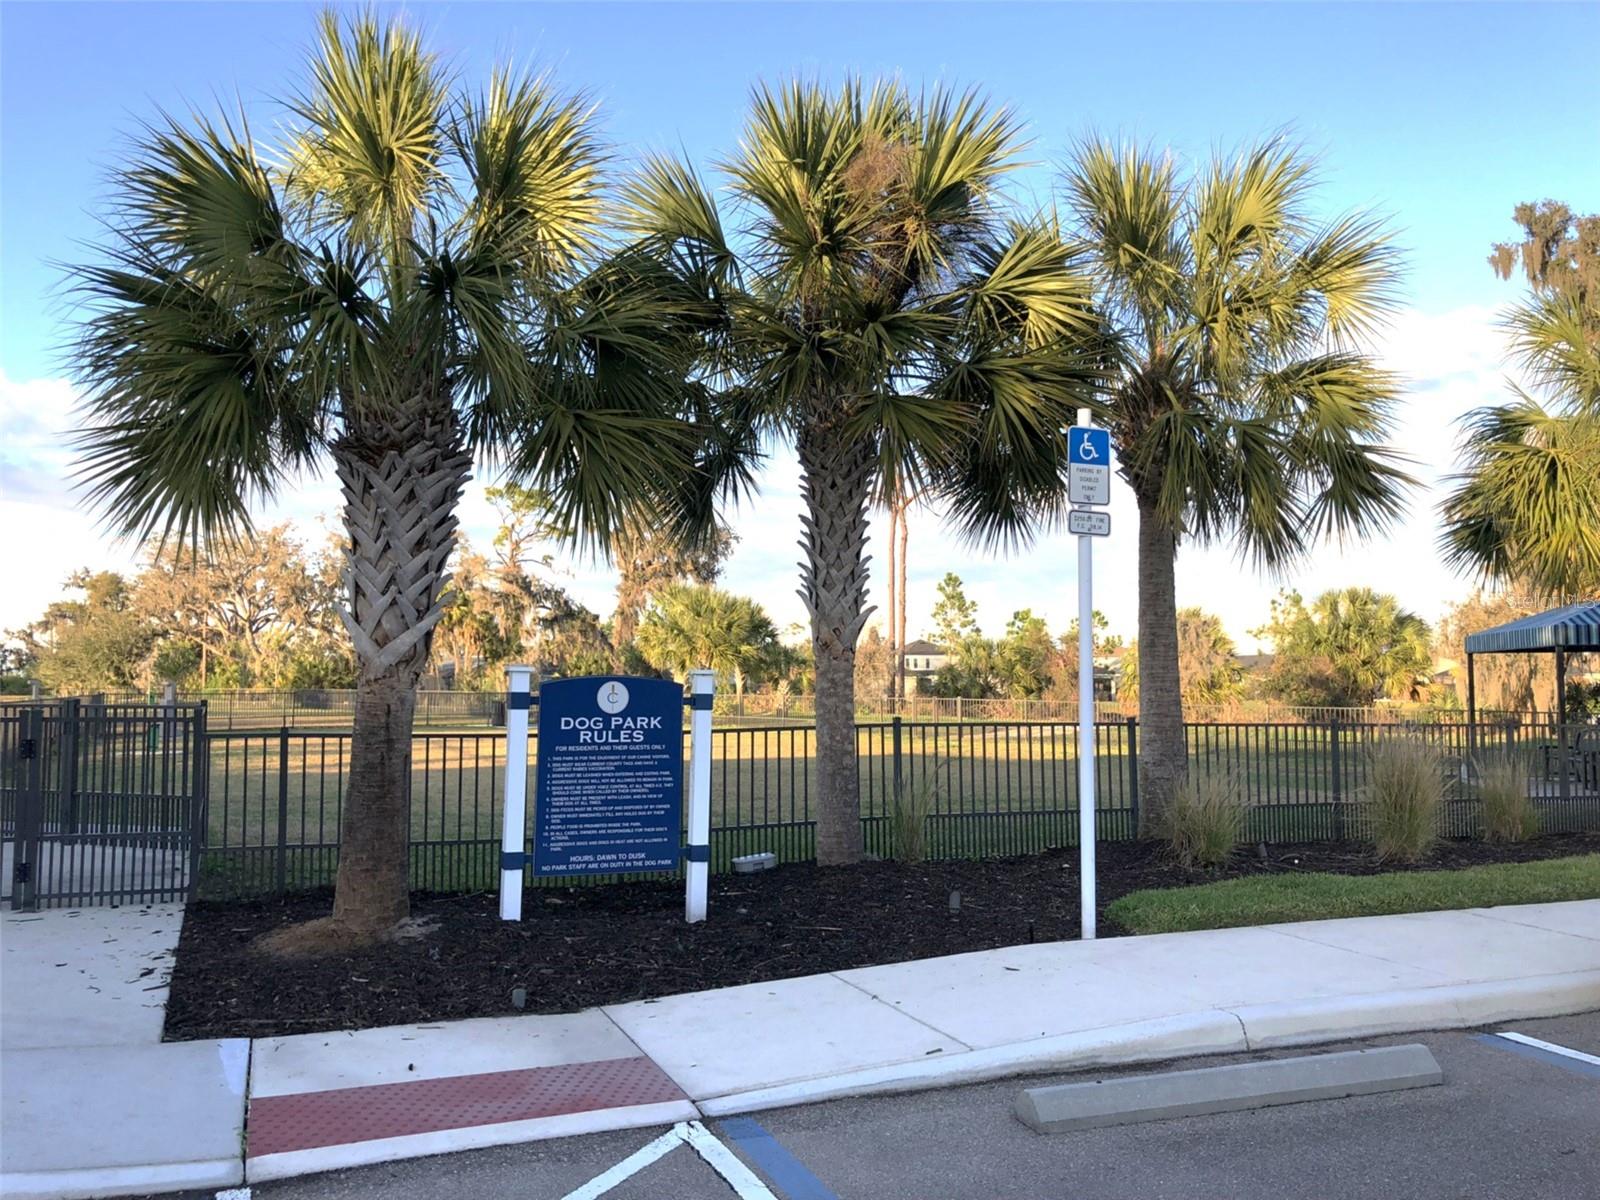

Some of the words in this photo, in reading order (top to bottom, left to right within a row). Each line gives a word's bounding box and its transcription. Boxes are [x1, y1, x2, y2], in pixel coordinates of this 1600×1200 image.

[561, 717, 603, 730] DOG
[611, 716, 662, 729] PARK
[580, 730, 644, 743] RULES
